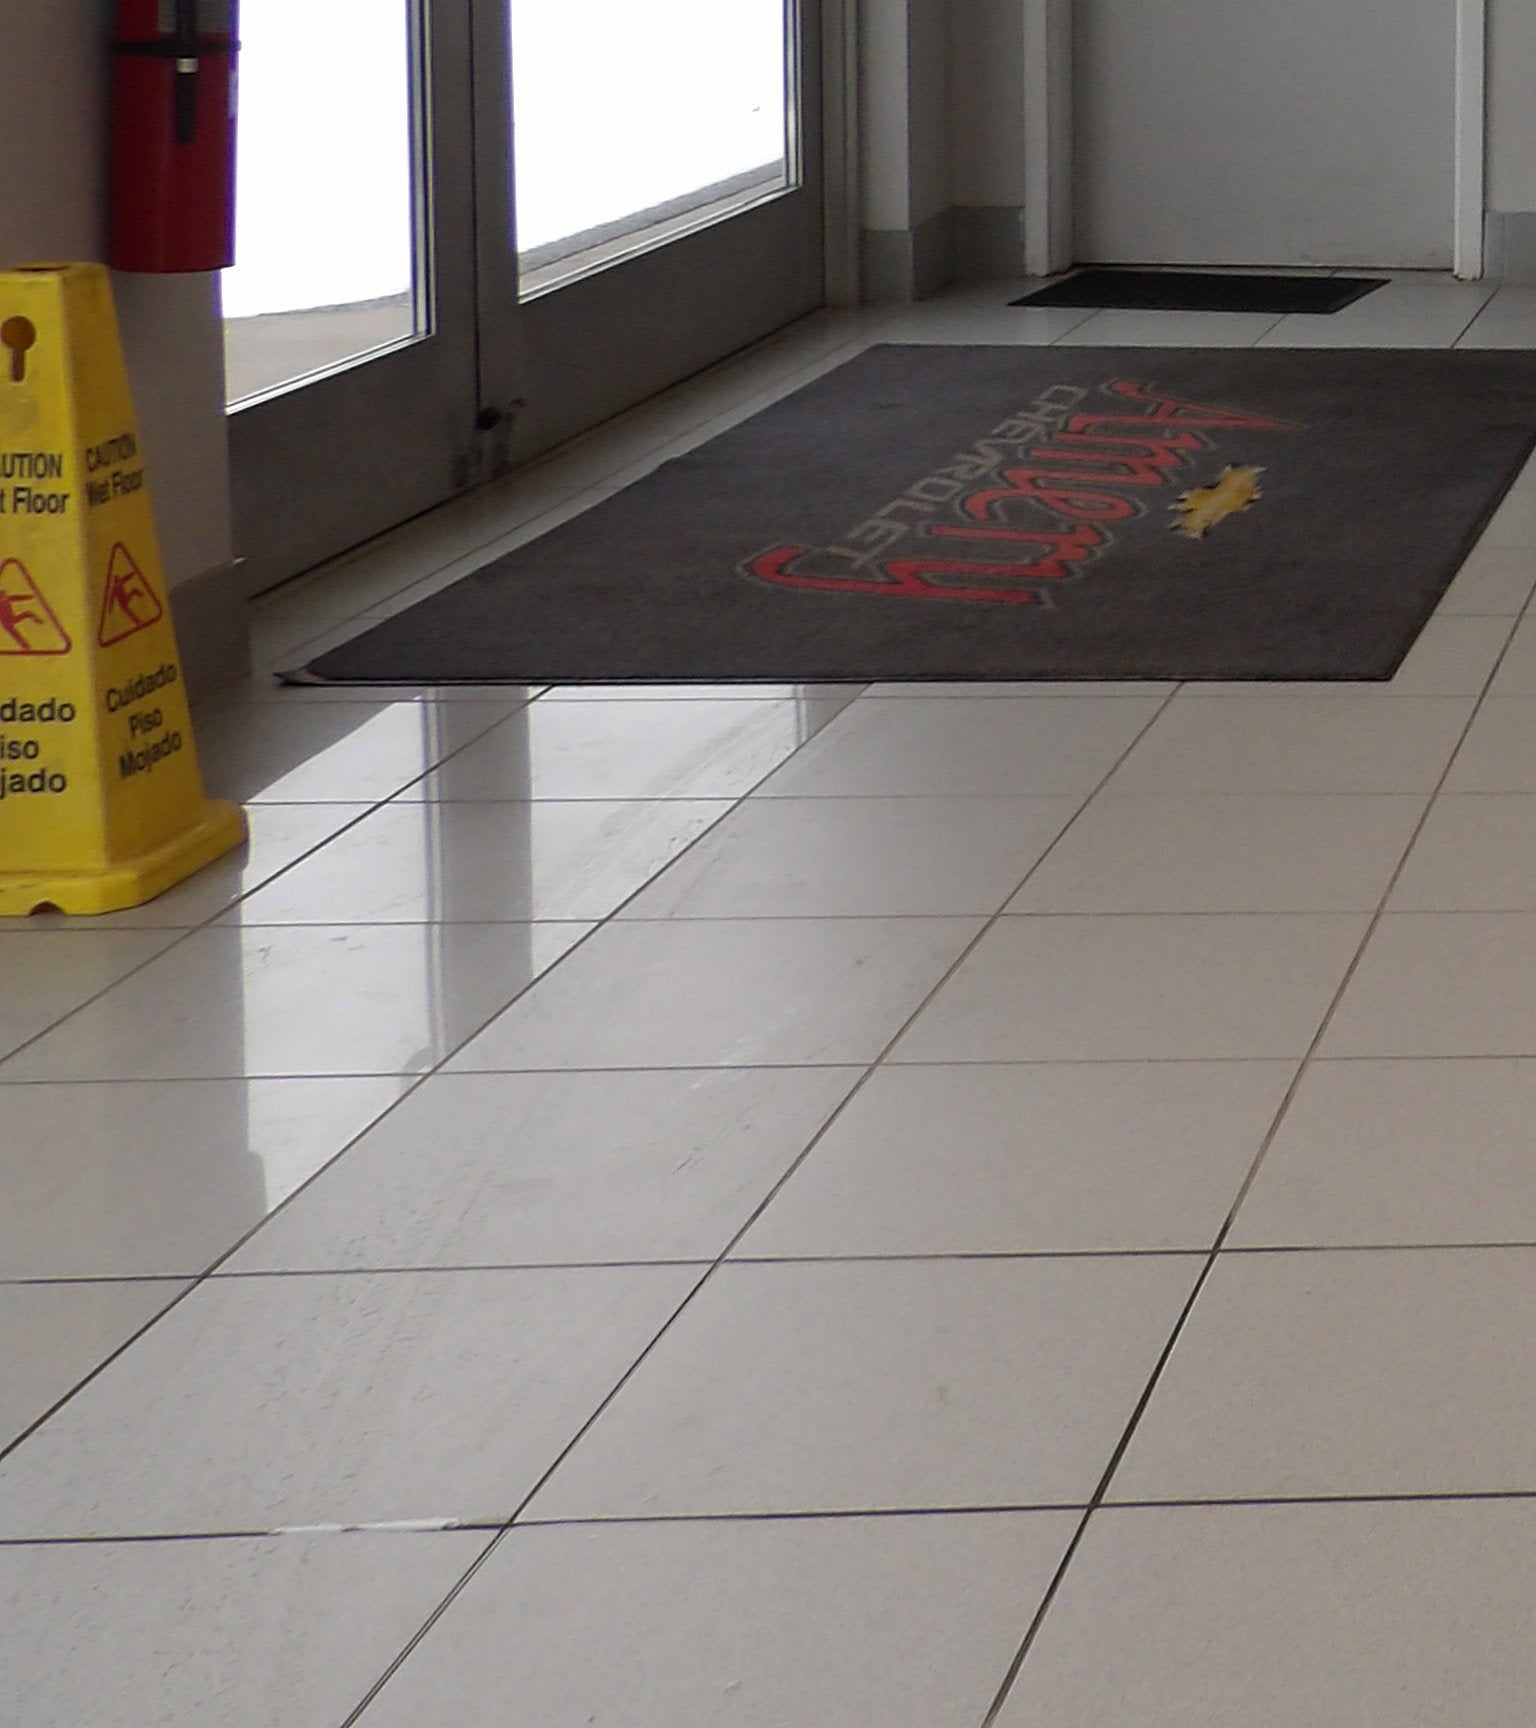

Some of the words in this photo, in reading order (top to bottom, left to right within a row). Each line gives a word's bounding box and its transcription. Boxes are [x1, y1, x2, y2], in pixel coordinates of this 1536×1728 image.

[0, 452, 63, 478] UTION
[86, 433, 137, 472] CAUTION
[112, 469, 144, 496] Floor
[752, 379, 1298, 604] Amery
[826, 384, 1088, 570] CHEVROLET
[13, 485, 69, 513] Floor
[106, 663, 178, 713] Cuidado
[0, 697, 76, 722] dado
[129, 707, 163, 739] Piso
[0, 734, 39, 760] iso
[118, 731, 182, 780] Mojado
[0, 767, 67, 800] jado
